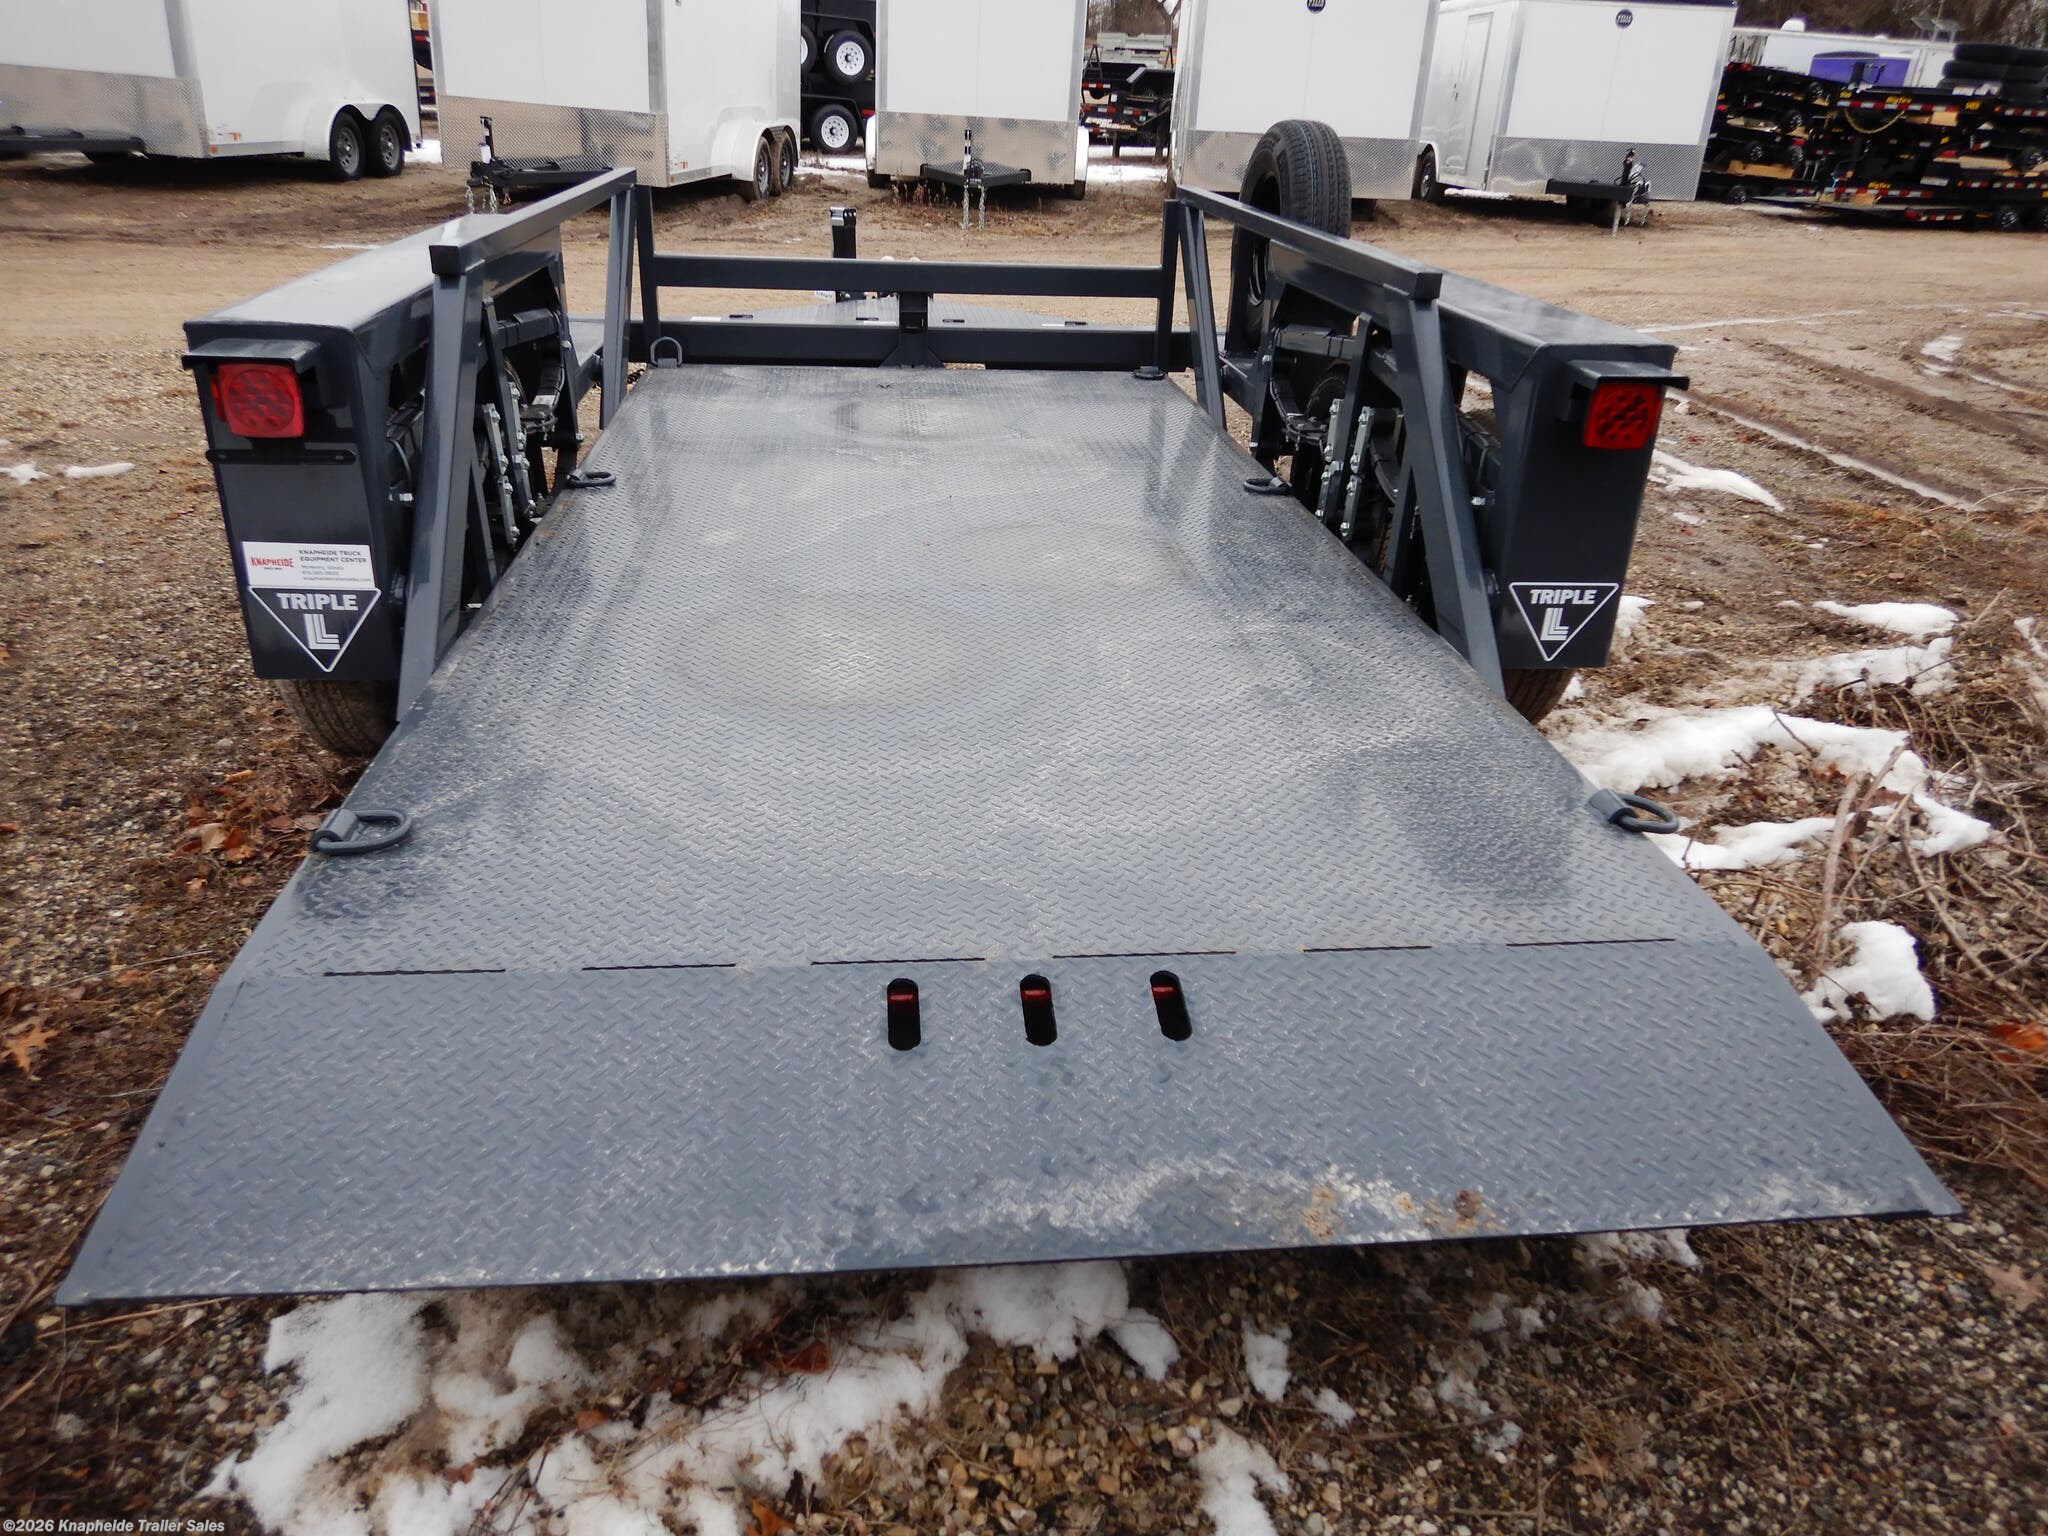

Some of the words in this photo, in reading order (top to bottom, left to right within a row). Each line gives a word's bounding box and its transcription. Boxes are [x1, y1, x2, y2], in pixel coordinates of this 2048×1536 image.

[251, 556, 294, 568] KNAPHEIDE
[277, 593, 358, 611] TRIPLE
[1530, 589, 1597, 604] TRIPLE
